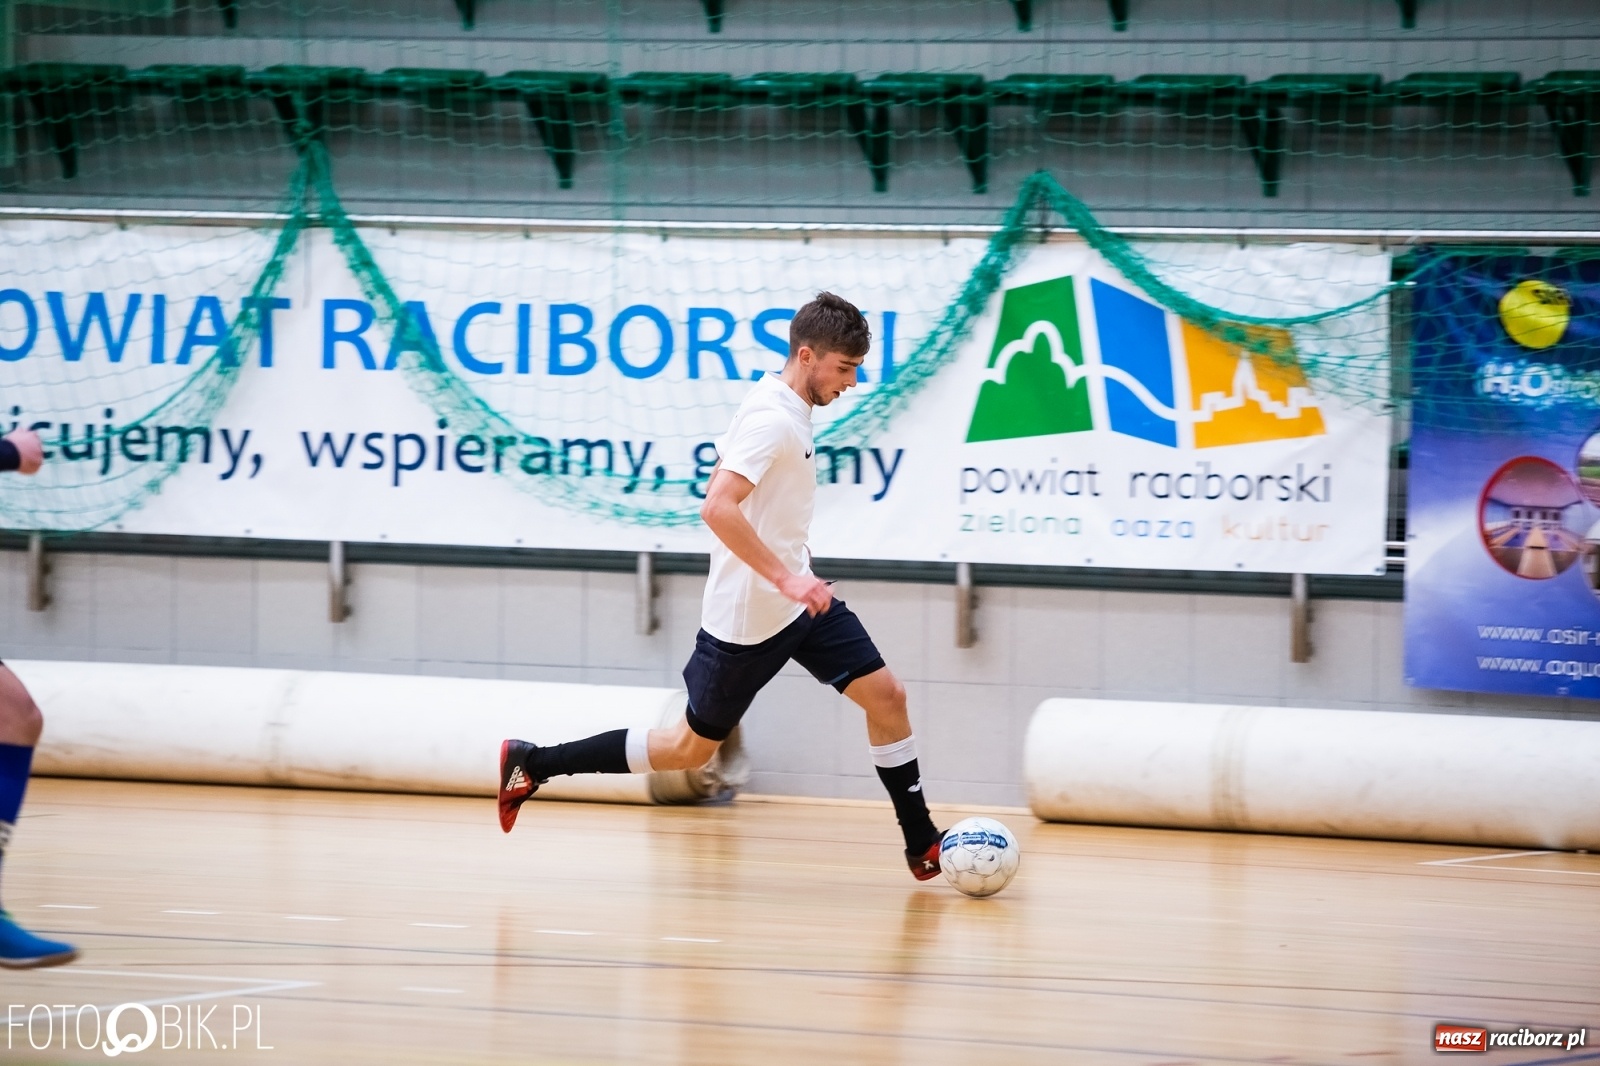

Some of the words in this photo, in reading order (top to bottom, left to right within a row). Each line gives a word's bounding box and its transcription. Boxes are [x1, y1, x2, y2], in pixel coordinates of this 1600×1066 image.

[322, 299, 897, 384] RACIBORSI
[302, 419, 666, 494] wspieramy,
[689, 442, 905, 501] gmy
[960, 458, 1102, 504] powiat
[1129, 461, 1332, 503] raciborski
[960, 509, 1082, 535] zielona
[1110, 515, 1196, 540] oaza
[1220, 514, 1330, 542] kultur
